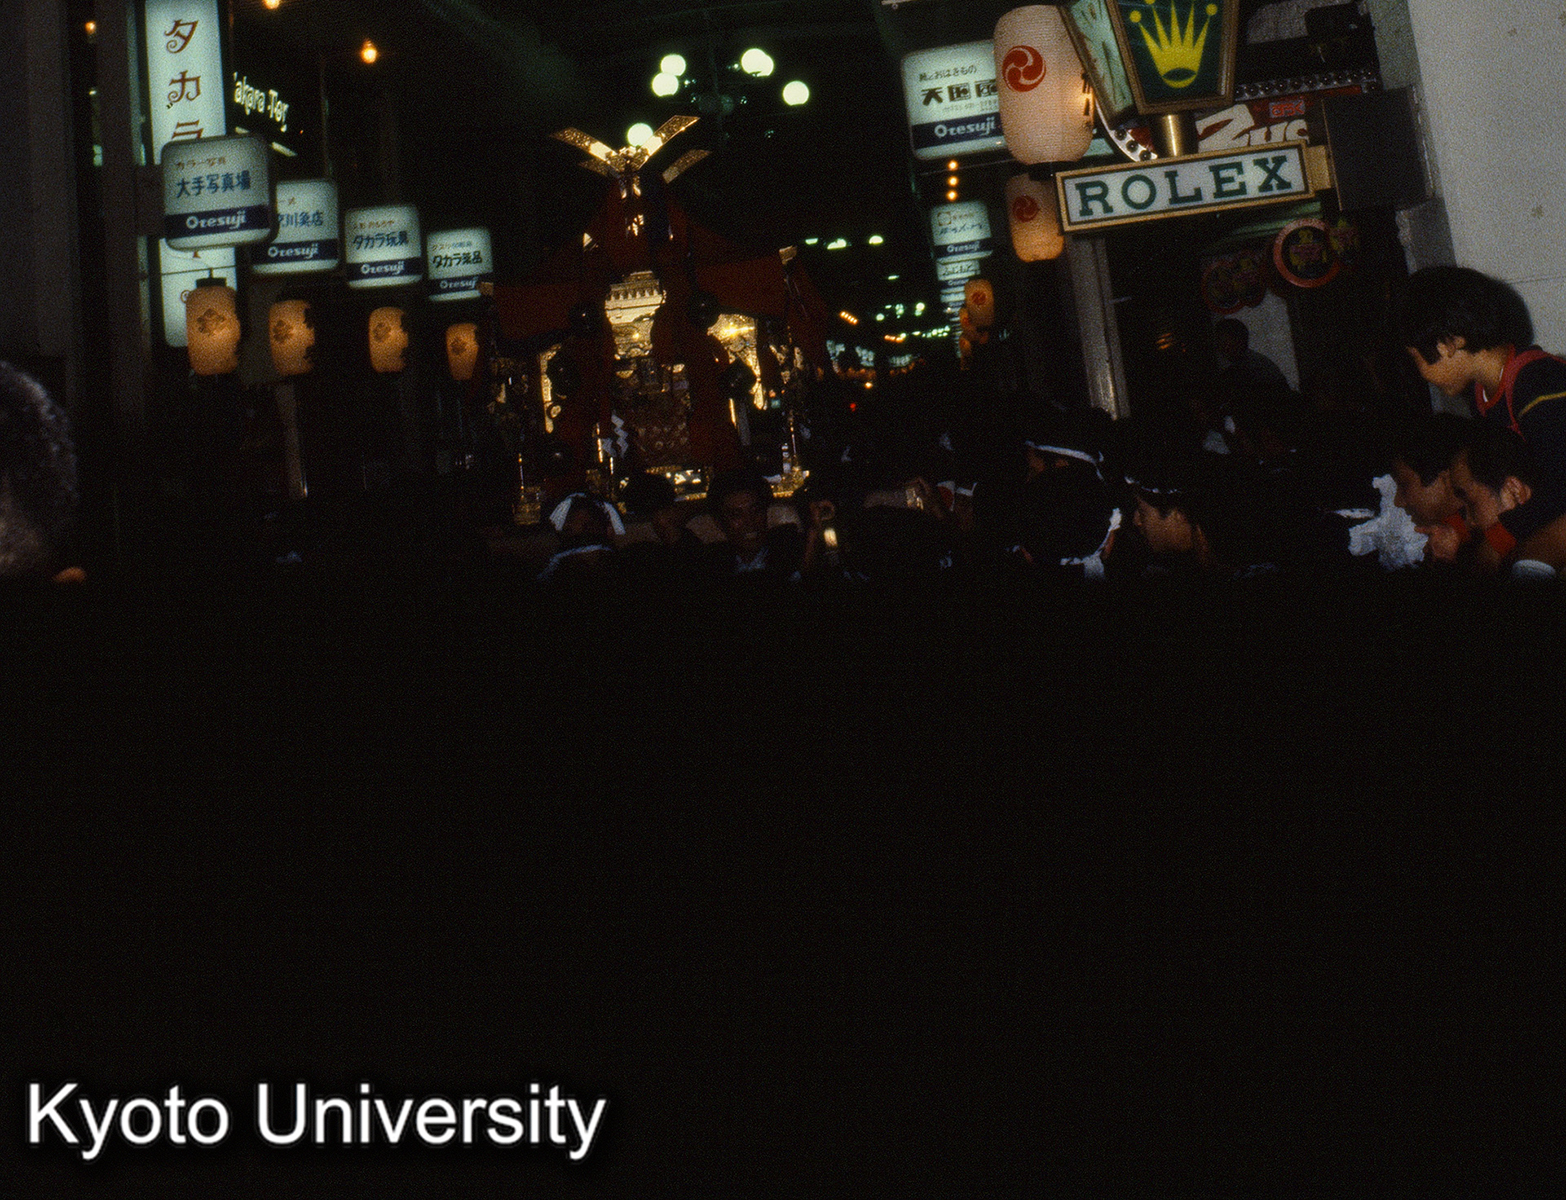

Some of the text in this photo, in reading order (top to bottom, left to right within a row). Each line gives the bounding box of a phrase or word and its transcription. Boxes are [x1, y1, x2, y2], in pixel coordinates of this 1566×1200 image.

[233, 71, 266, 115] akara
[934, 116, 997, 138] Otesuji
[1075, 155, 1292, 217] ROLEX
[186, 211, 247, 230] Otesuji
